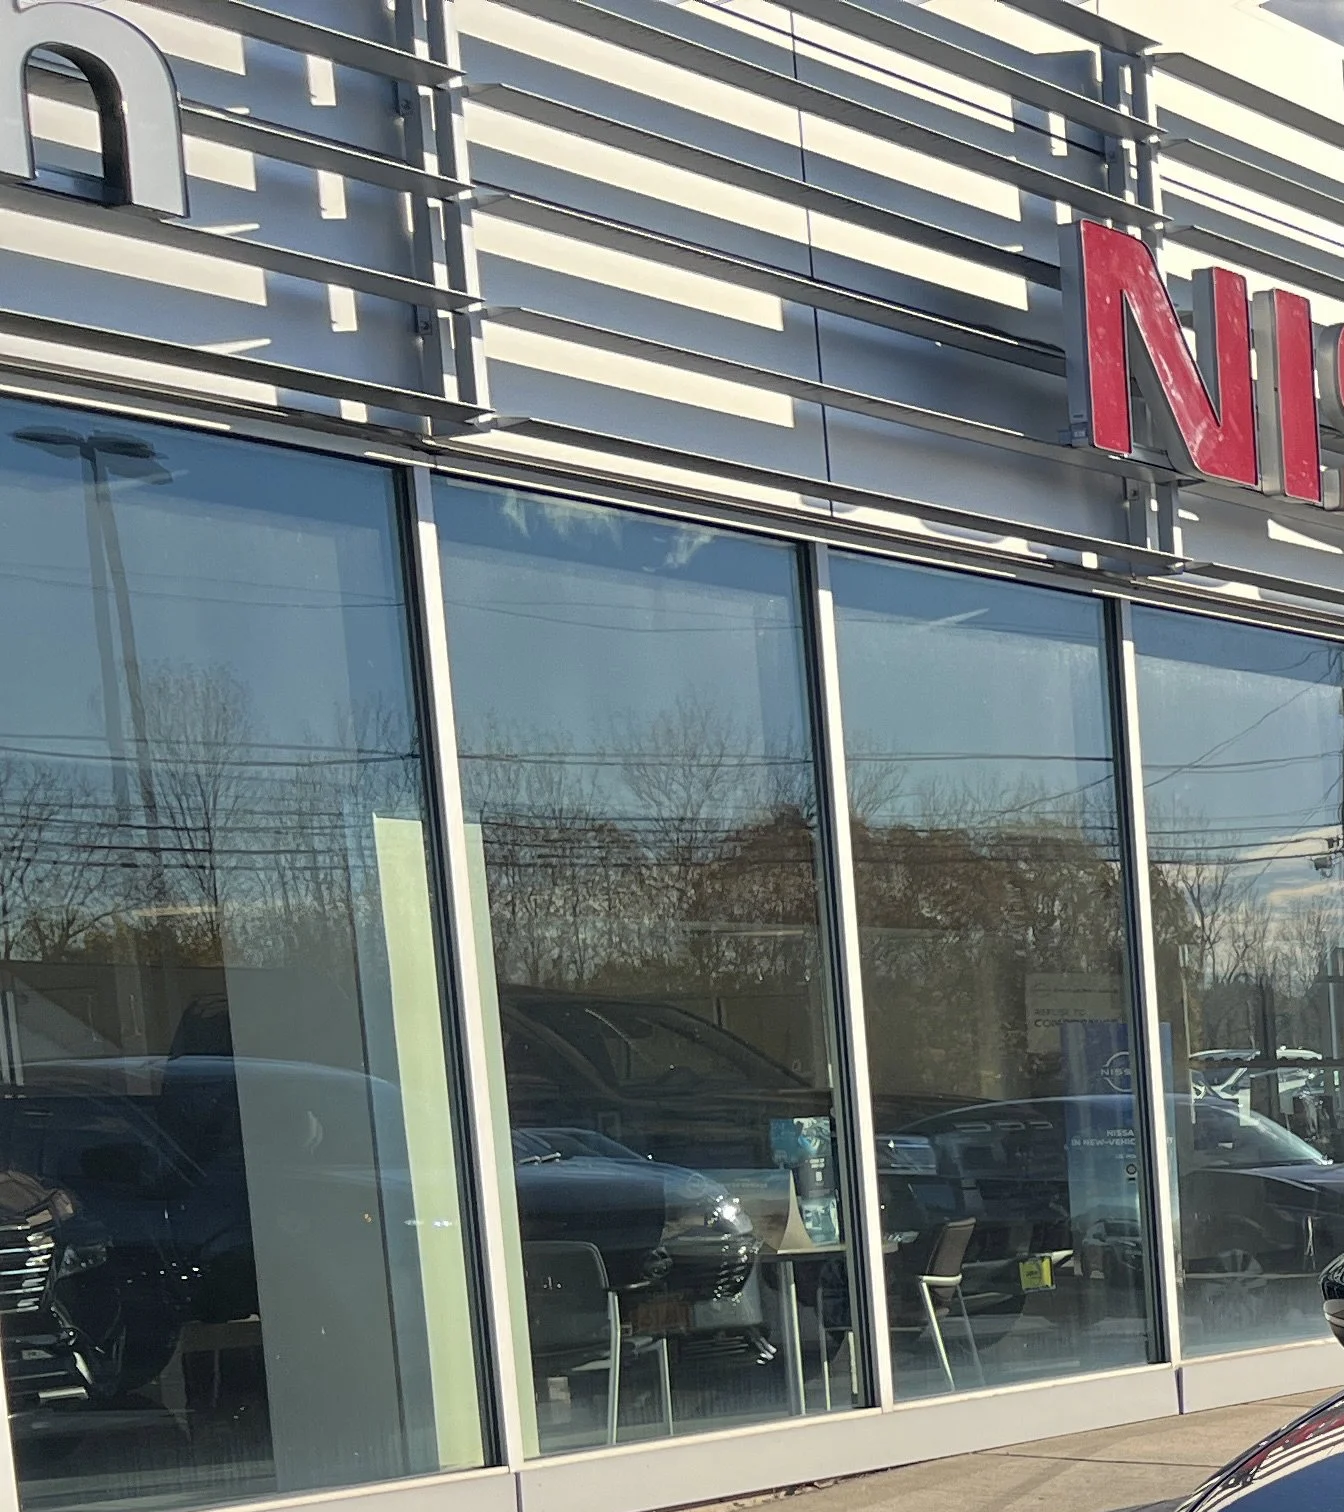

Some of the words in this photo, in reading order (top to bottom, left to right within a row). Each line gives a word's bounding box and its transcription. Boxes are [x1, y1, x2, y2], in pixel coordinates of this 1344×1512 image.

[1100, 1068, 1131, 1076] NISS
[1106, 1129, 1135, 1137] NISSA
[1083, 1138, 1137, 1147] NEW-VEHIC
